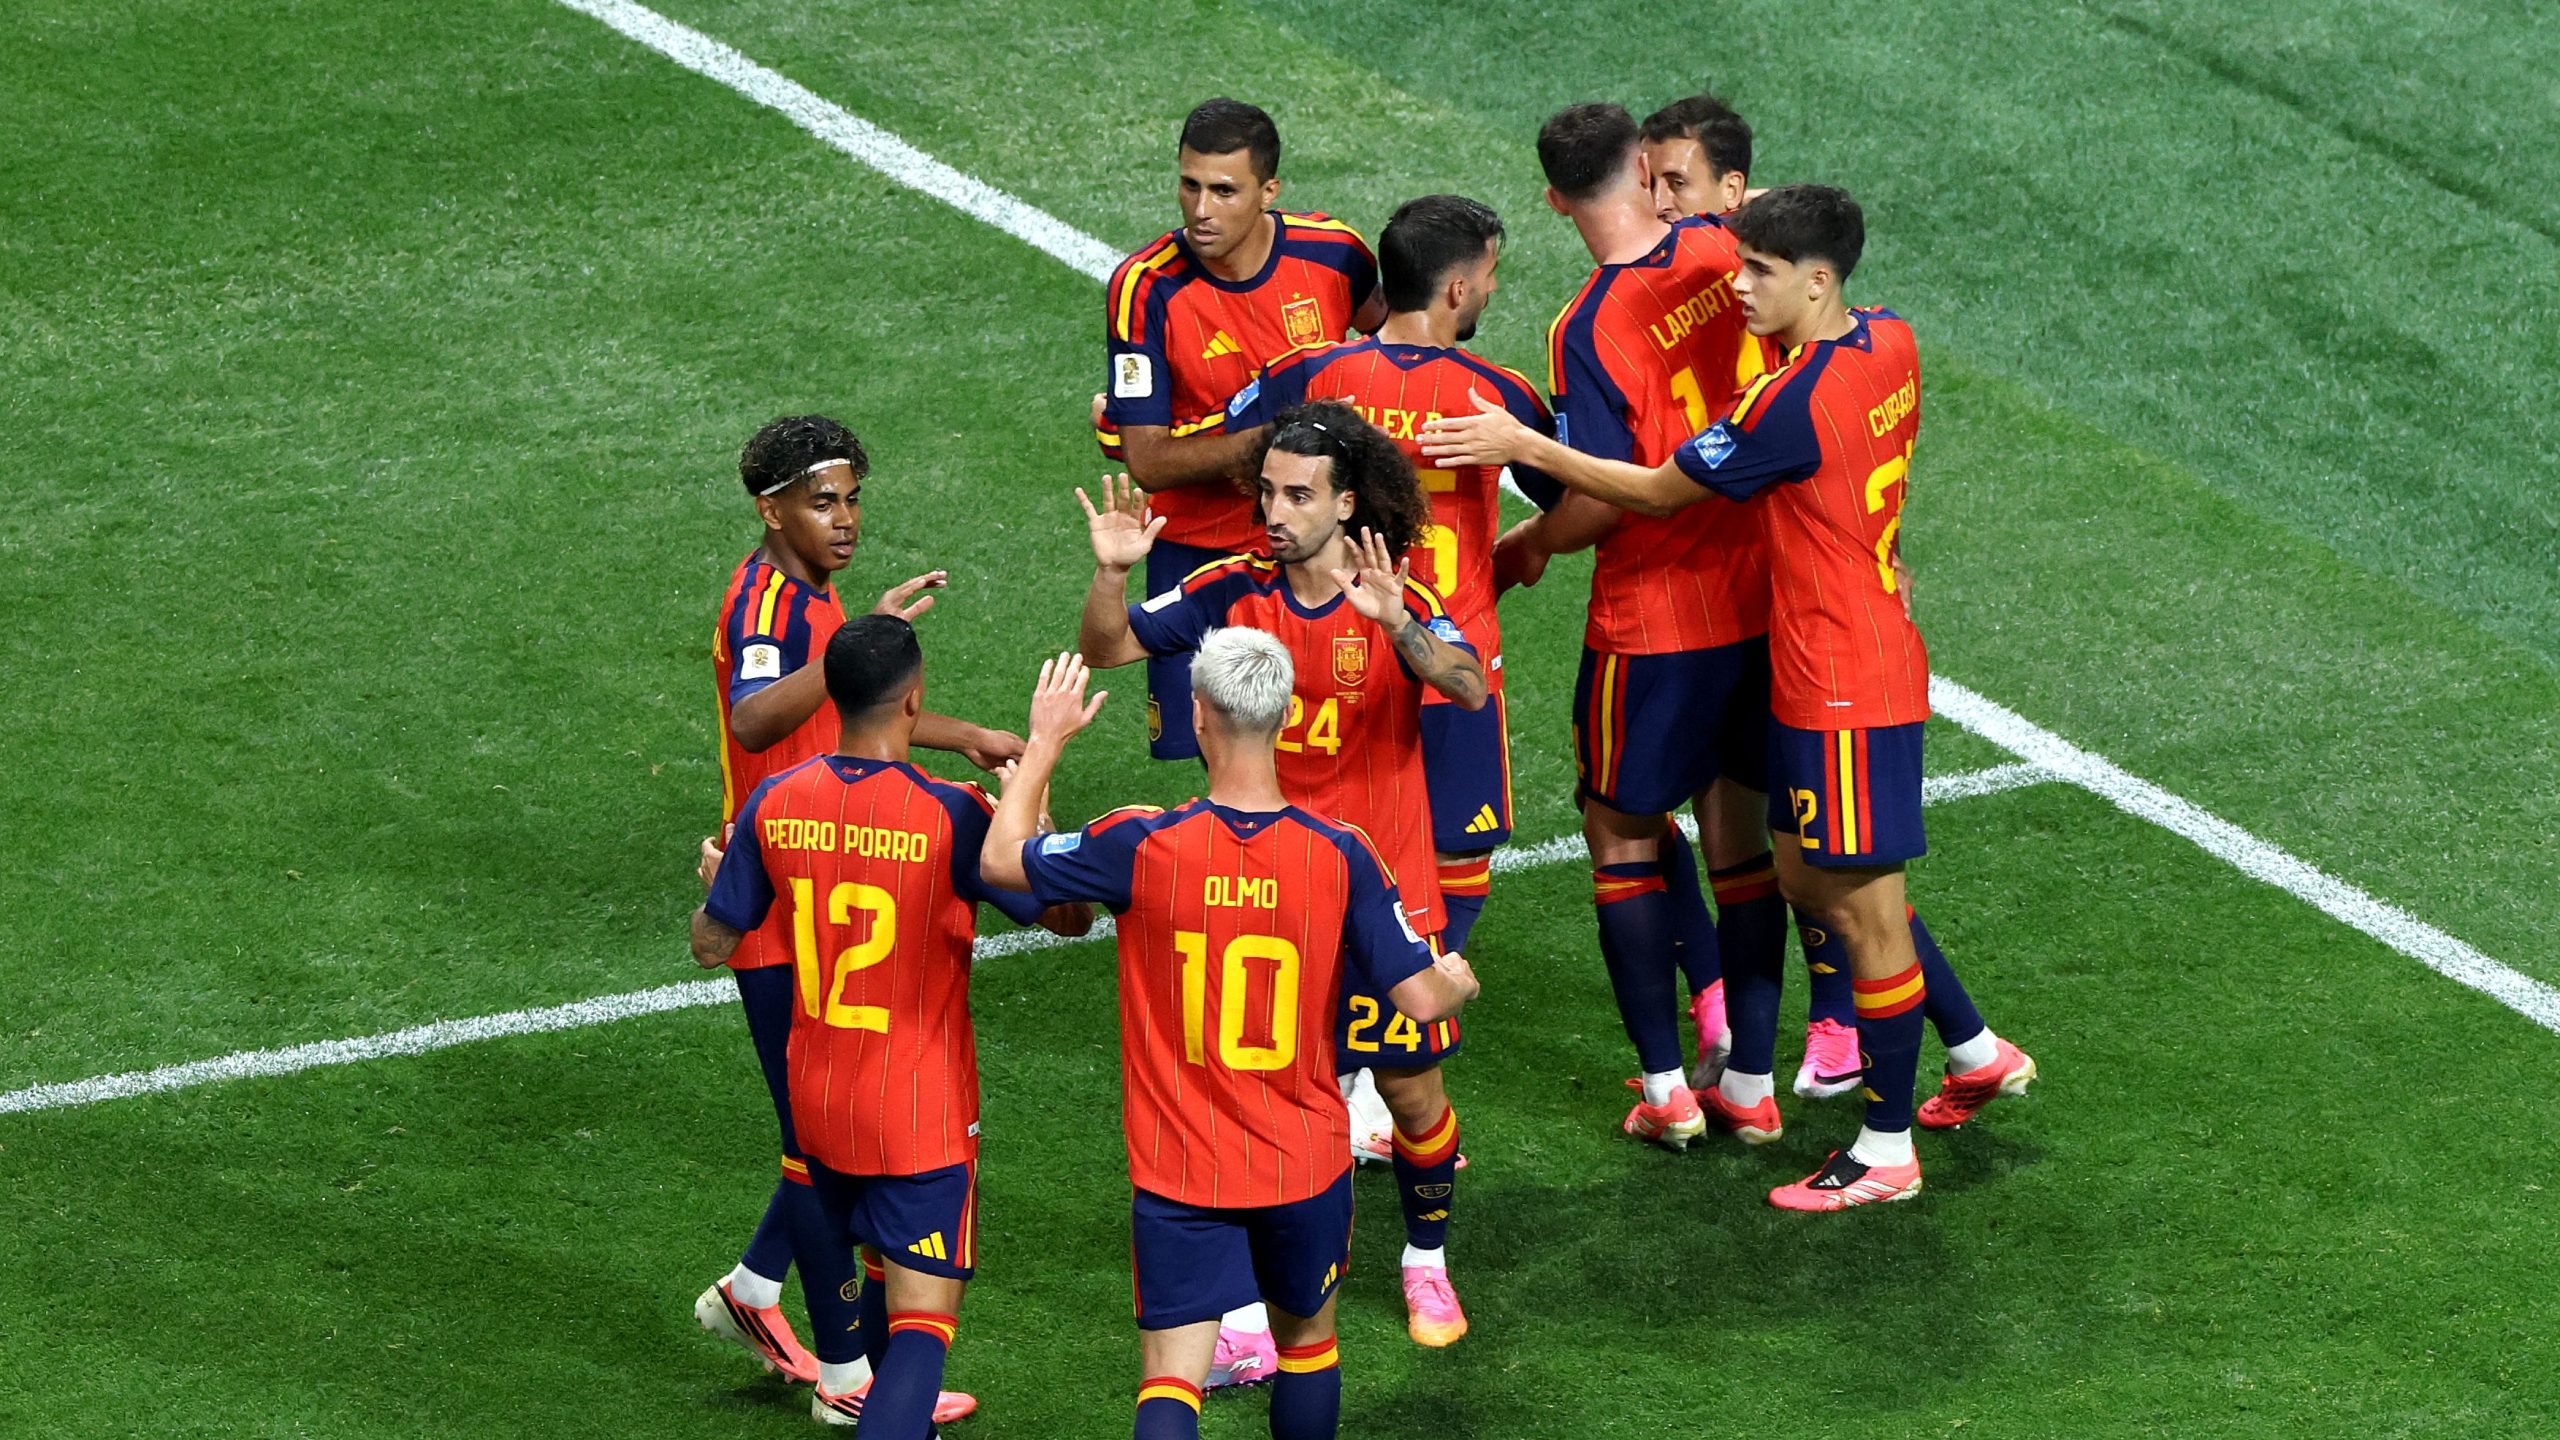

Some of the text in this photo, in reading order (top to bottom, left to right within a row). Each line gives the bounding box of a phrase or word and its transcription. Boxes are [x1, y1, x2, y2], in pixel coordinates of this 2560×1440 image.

[1353, 405, 1418, 441] LEX
[1274, 694, 1342, 756] 24
[763, 818, 929, 864] PEDRO PORRO
[1203, 875, 1279, 910] OLMO
[787, 876, 897, 1035] 12
[1174, 929, 1301, 1072] 10
[1346, 994, 1422, 1053] 24
